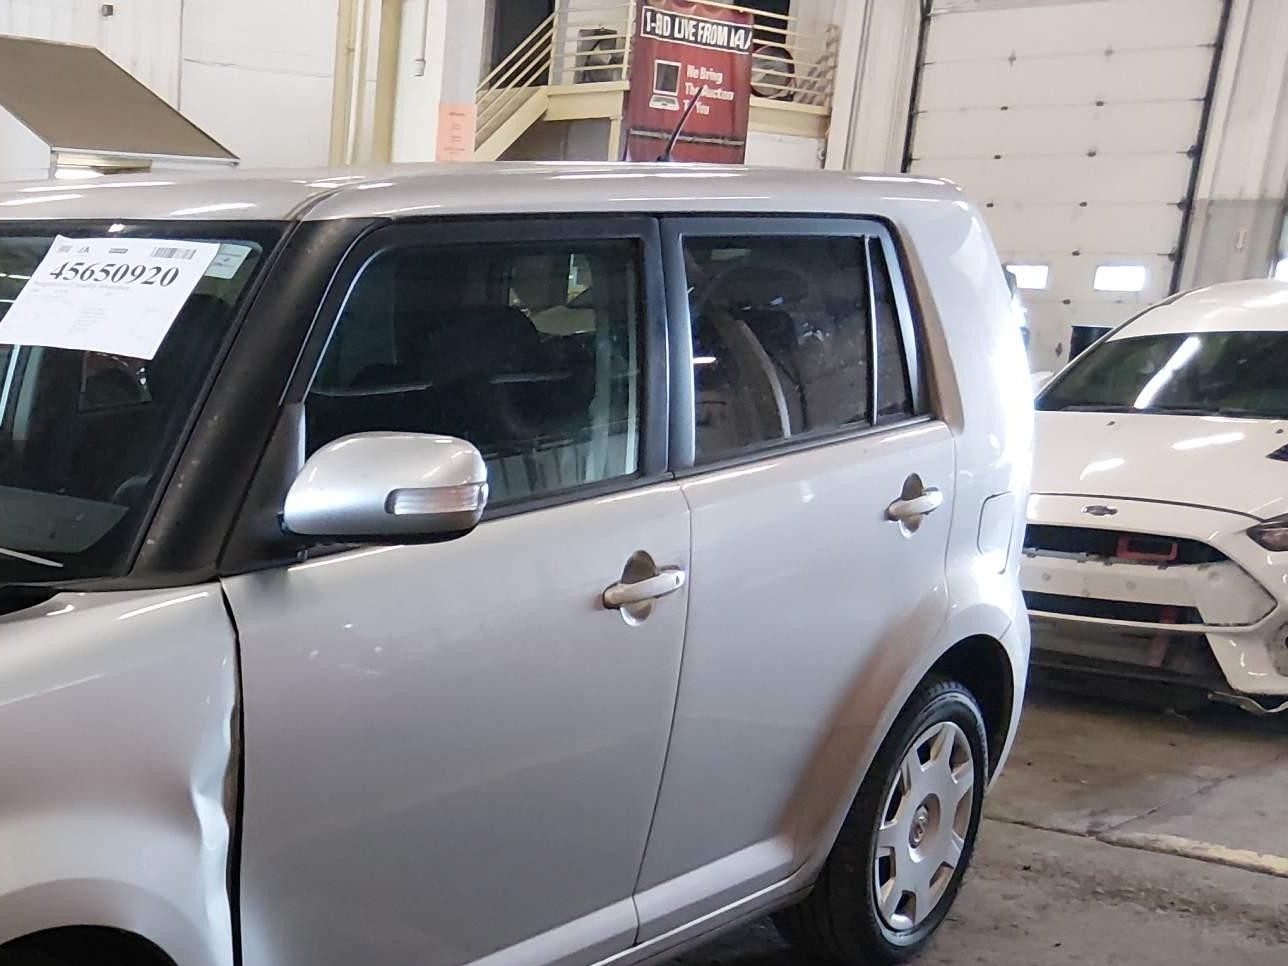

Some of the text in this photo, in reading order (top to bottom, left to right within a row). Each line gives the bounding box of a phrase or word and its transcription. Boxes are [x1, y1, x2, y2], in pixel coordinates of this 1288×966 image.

[674, 17, 697, 41] LIVE
[697, 22, 728, 46] FROM
[699, 66, 723, 84] Bring
[49, 261, 180, 287] 45650920
